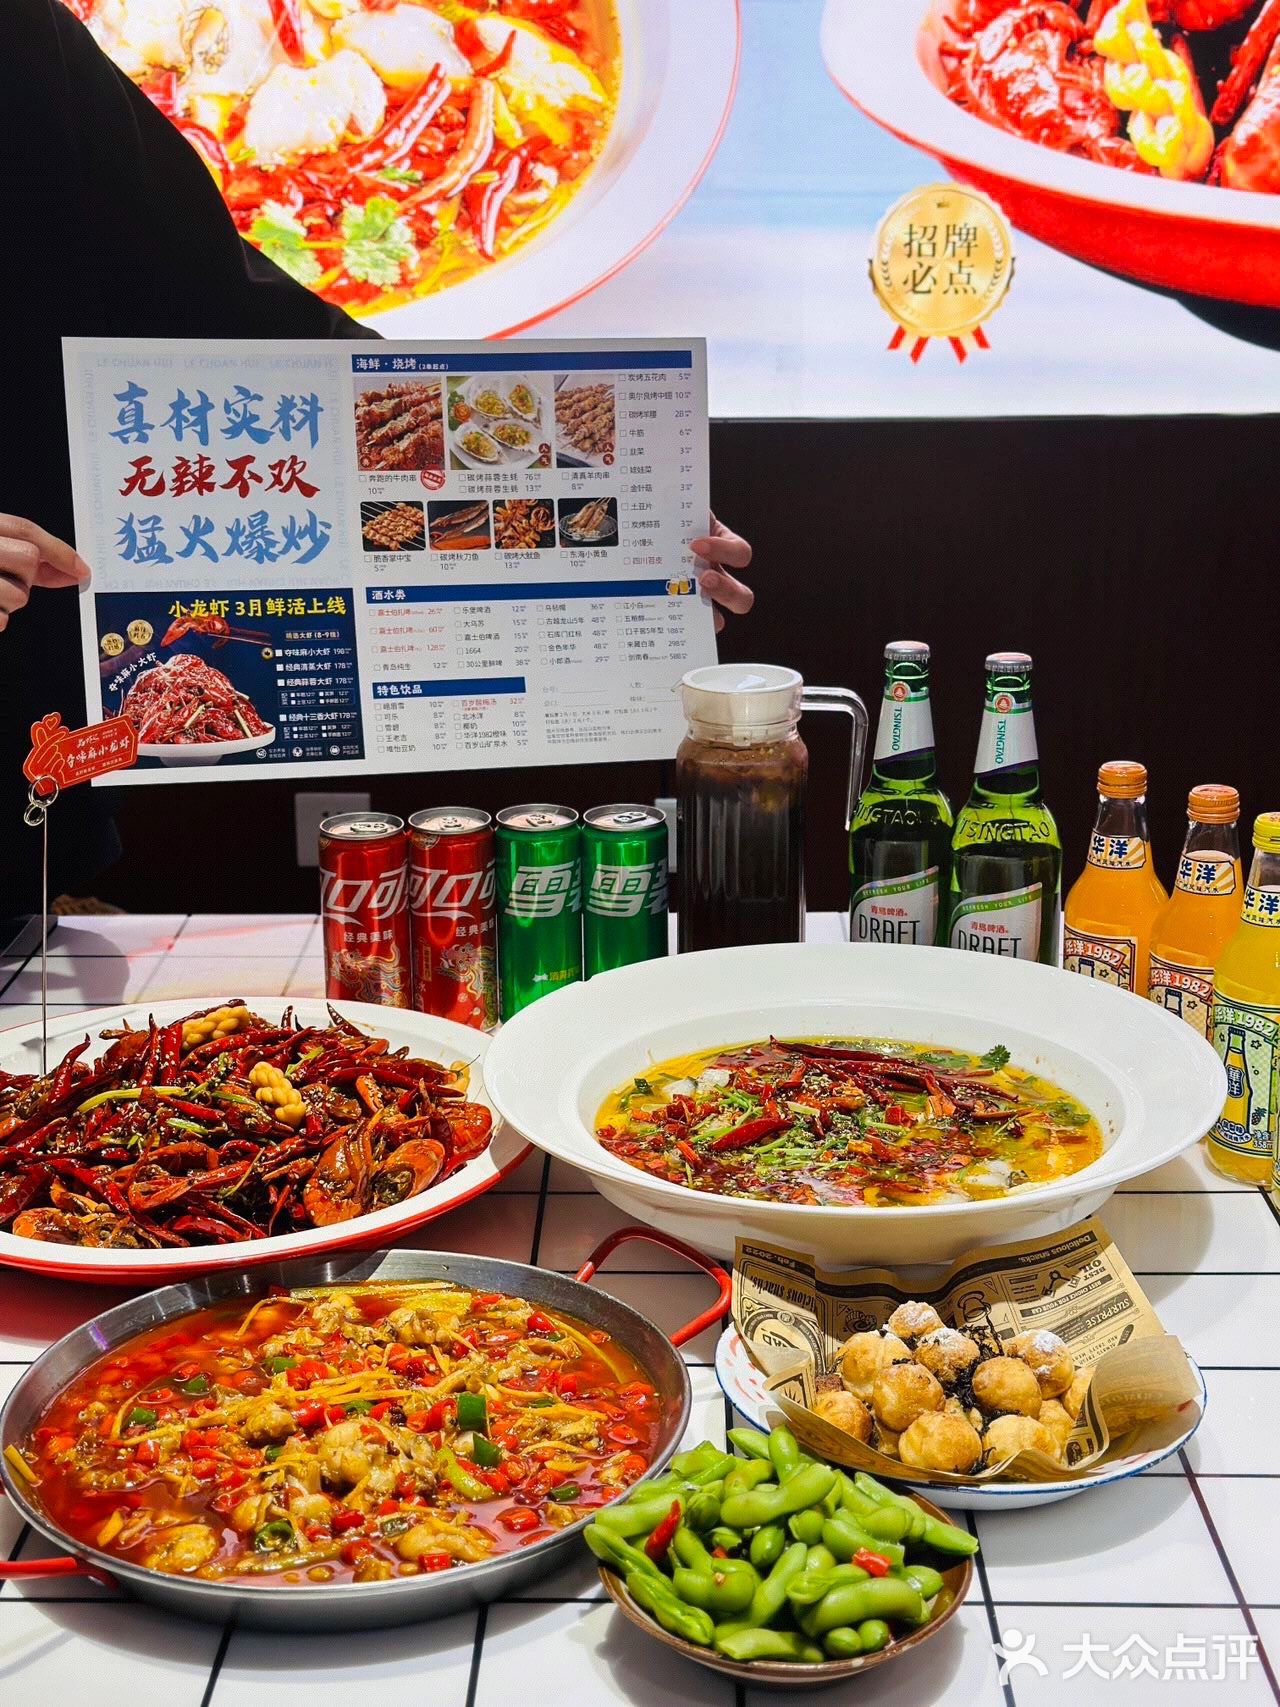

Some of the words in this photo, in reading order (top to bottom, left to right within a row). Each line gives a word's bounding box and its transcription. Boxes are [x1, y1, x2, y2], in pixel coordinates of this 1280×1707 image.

[902, 222, 979, 259] 招牌
[902, 259, 978, 295] 必点
[108, 380, 325, 449] 真材实料
[118, 453, 321, 499] 无辣不欢
[113, 508, 333, 566] 猛火爆炒
[371, 589, 407, 600] 酒水类
[377, 684, 423, 696] 特色饮品
[891, 706, 903, 751] TSINGTAO
[995, 719, 1006, 764] TSINGTAO
[958, 817, 1051, 842] TSINGTAO
[1092, 834, 1129, 858] 华洋
[1179, 859, 1217, 884] 华洋
[1243, 887, 1280, 916] 华洋
[343, 929, 393, 943] 经典美味
[859, 913, 921, 945] DRAFT
[958, 929, 1022, 958] DRAFT
[1052, 1234, 1092, 1256] Delicious
[1069, 1286, 1089, 1300] CHOICE
[1089, 1281, 1102, 1291] BEST
[1031, 1306, 1043, 1315] CAR
[1042, 1299, 1058, 1311] YOUR
[1058, 1295, 1070, 1305] FOR
[1085, 1298, 1130, 1328] SURPRISE
